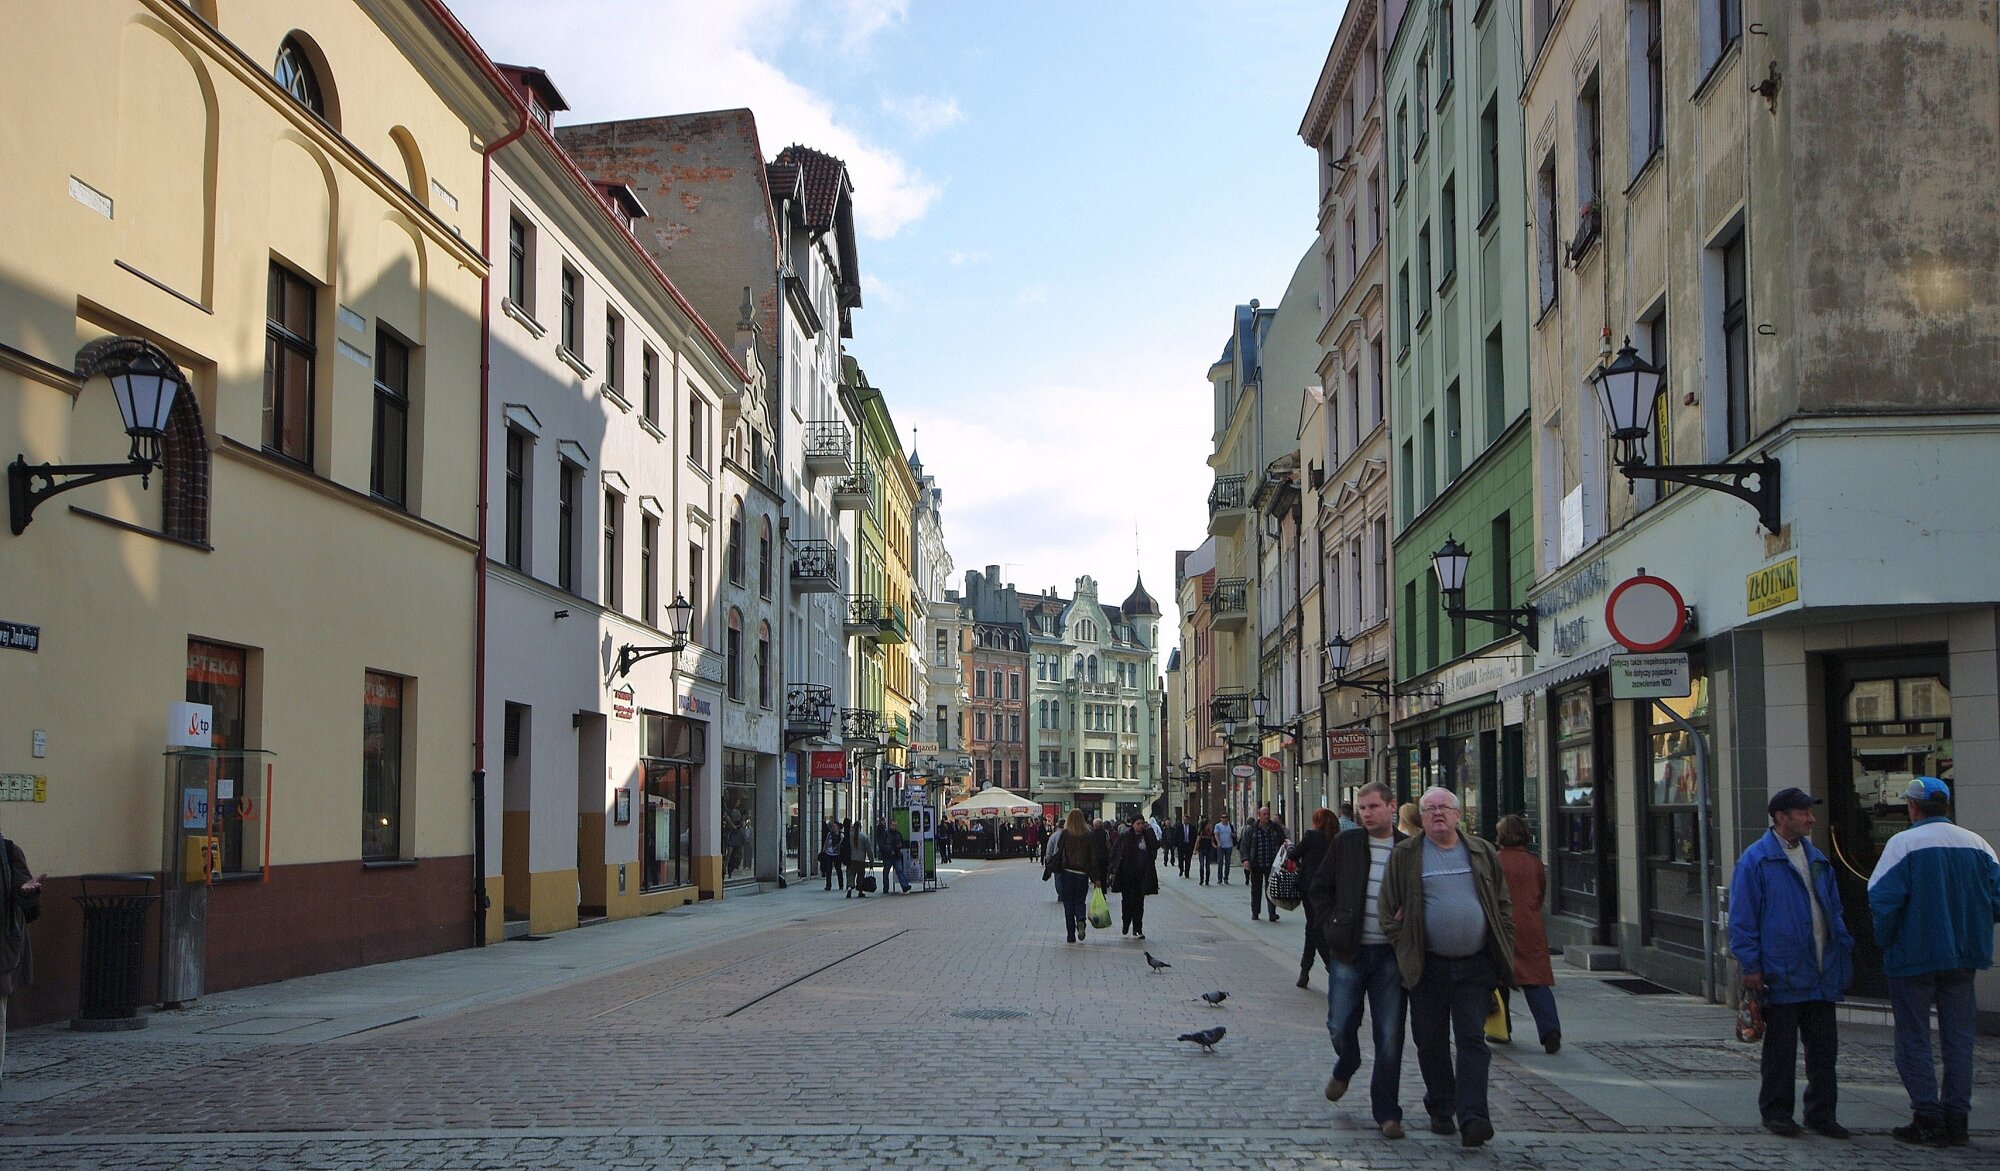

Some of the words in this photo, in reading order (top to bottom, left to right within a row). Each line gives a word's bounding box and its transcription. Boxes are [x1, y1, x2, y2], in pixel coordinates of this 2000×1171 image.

[1749, 561, 1795, 602] ZŁOTNIK
[187, 654, 239, 676] PTEKA
[200, 719, 209, 734] tp
[1332, 733, 1366, 744] KANTOR
[1333, 746, 1367, 755] EXCHANGE
[815, 761, 843, 770] Triumph
